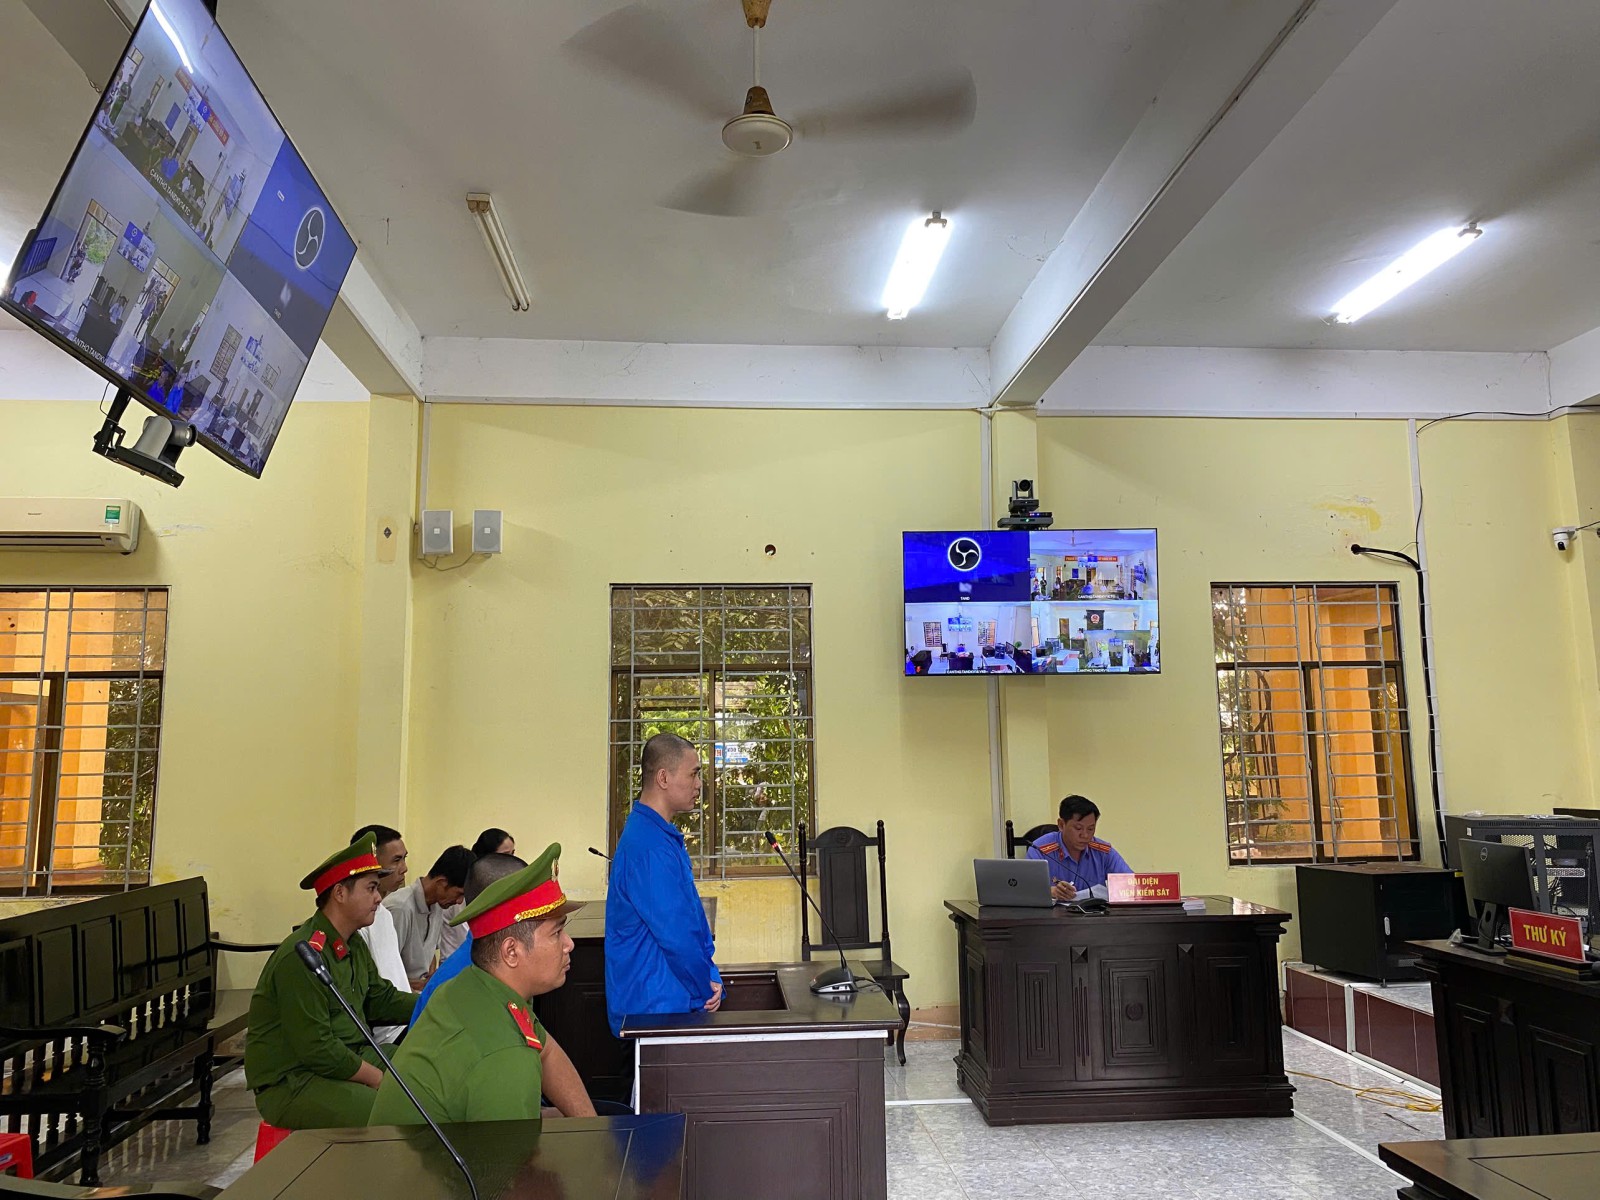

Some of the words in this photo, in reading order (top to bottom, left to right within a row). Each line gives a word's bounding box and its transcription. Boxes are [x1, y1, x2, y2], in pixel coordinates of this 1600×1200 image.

[1142, 876, 1159, 887] DIỆN
[1156, 887, 1170, 896] SÁT
[1523, 924, 1548, 944] THƯ
[1550, 927, 1567, 947] KÝ
